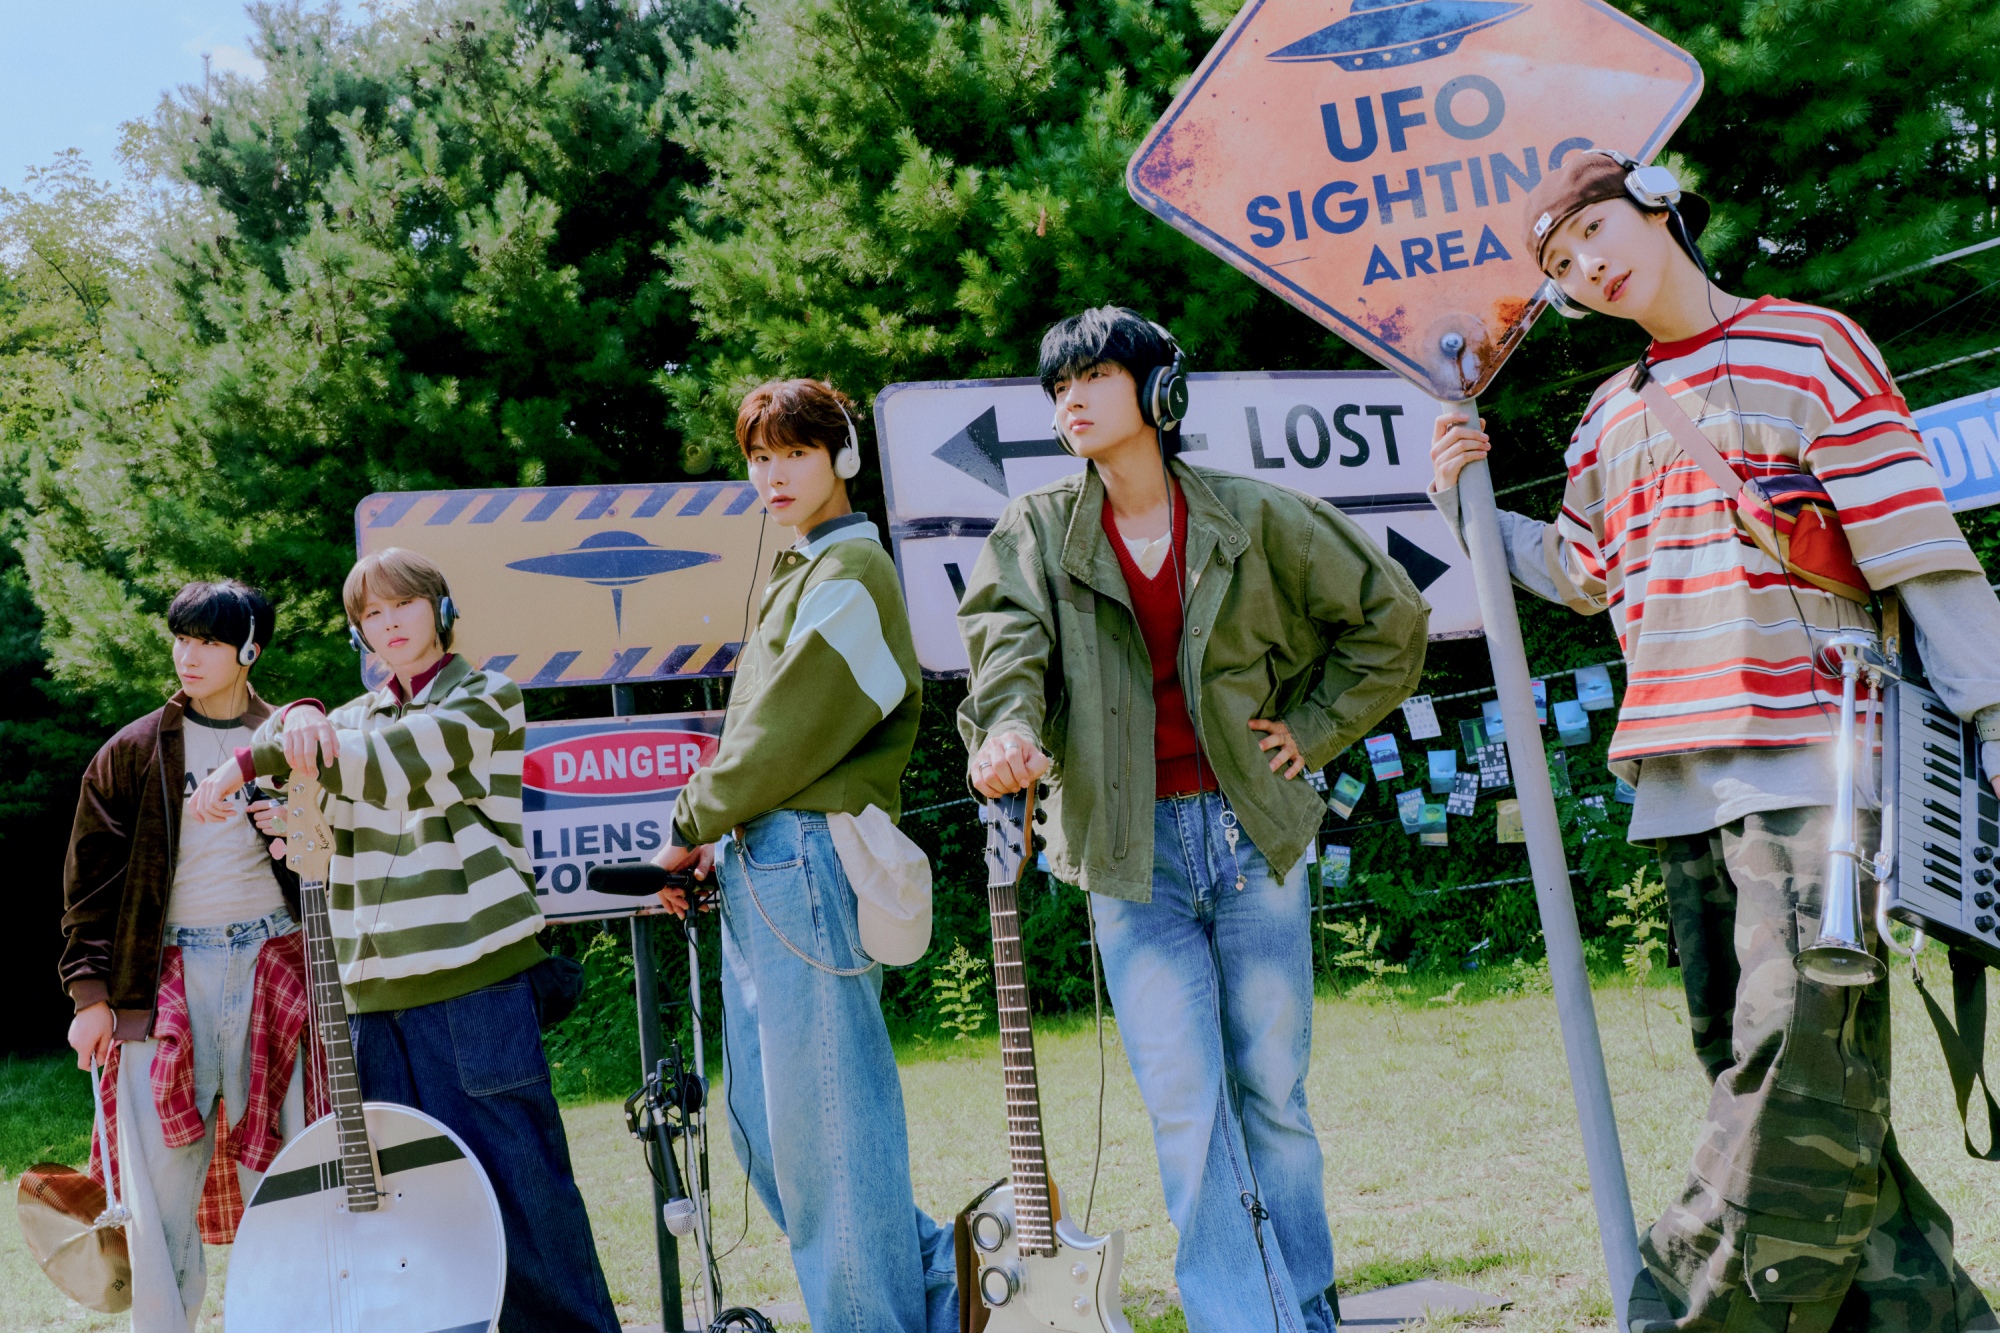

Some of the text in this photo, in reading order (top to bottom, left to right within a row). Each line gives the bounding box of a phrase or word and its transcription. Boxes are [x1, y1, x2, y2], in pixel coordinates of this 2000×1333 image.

[1320, 75, 1505, 162] UFO
[1362, 223, 1513, 287] AREA
[1244, 404, 1404, 469] LOST
[553, 743, 701, 784] DANGER
[530, 820, 662, 860] LIENS
